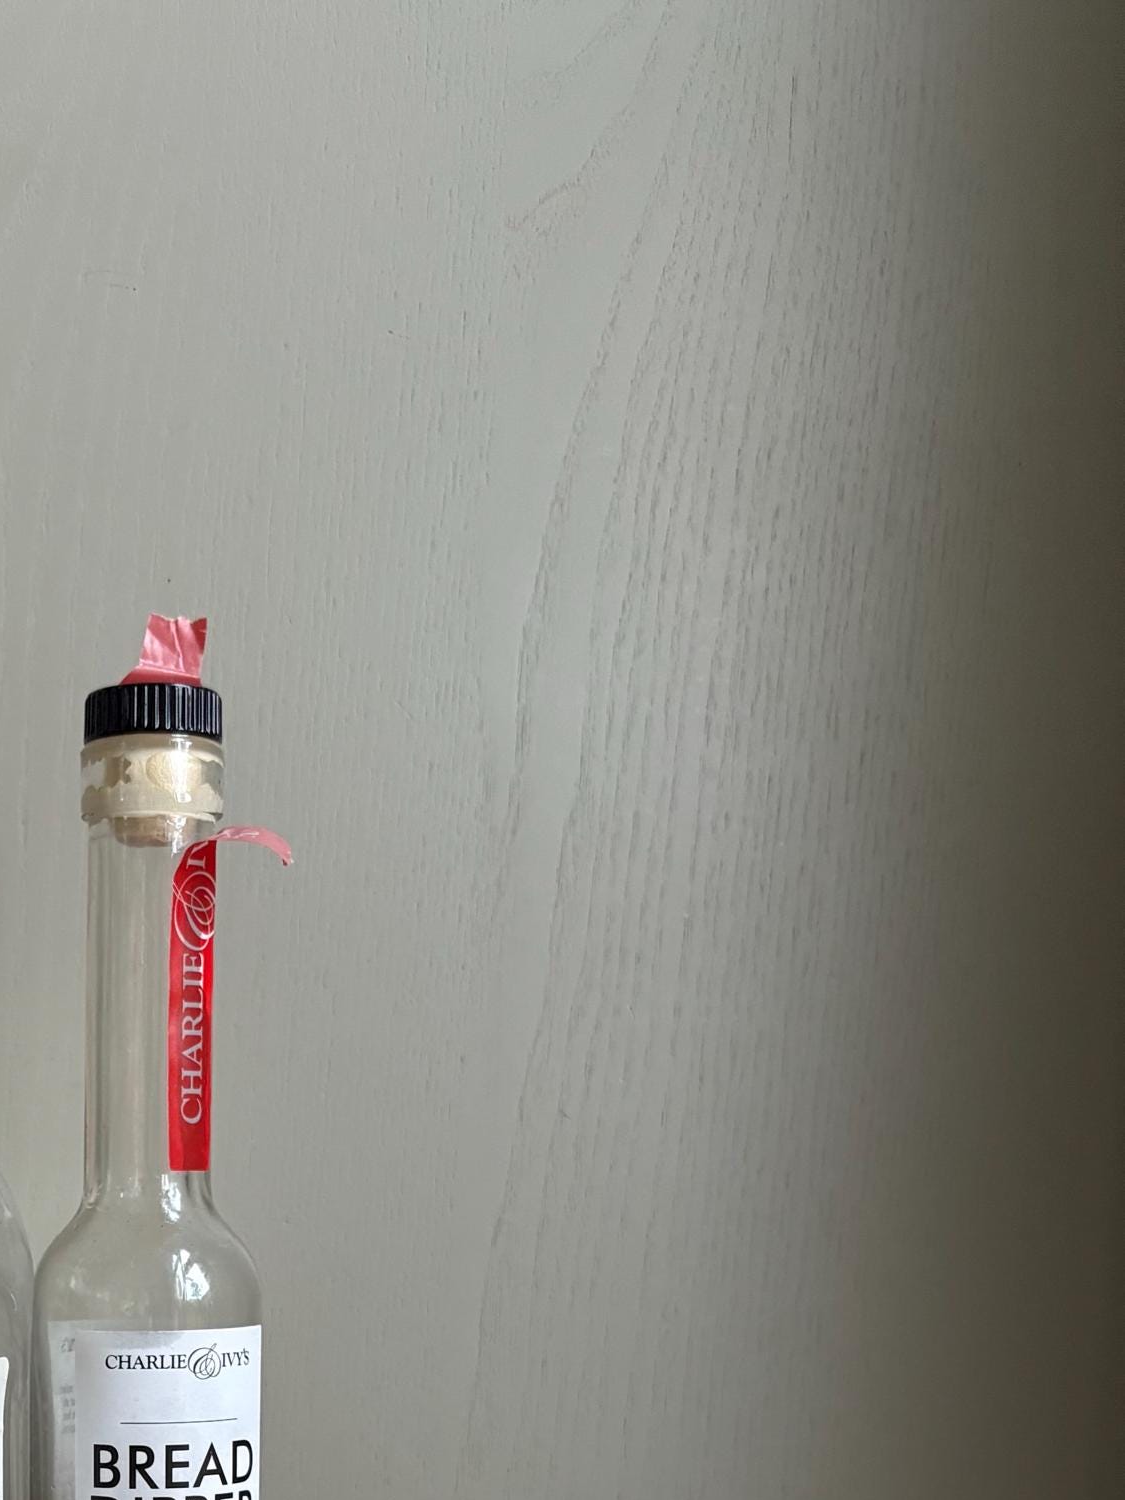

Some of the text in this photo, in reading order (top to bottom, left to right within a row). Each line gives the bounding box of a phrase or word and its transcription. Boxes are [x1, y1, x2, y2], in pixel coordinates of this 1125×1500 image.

[181, 952, 205, 1124] CHARLIE
[105, 1343, 250, 1380] CHARLIE & IVY'S
[93, 1439, 253, 1489] BREAD
